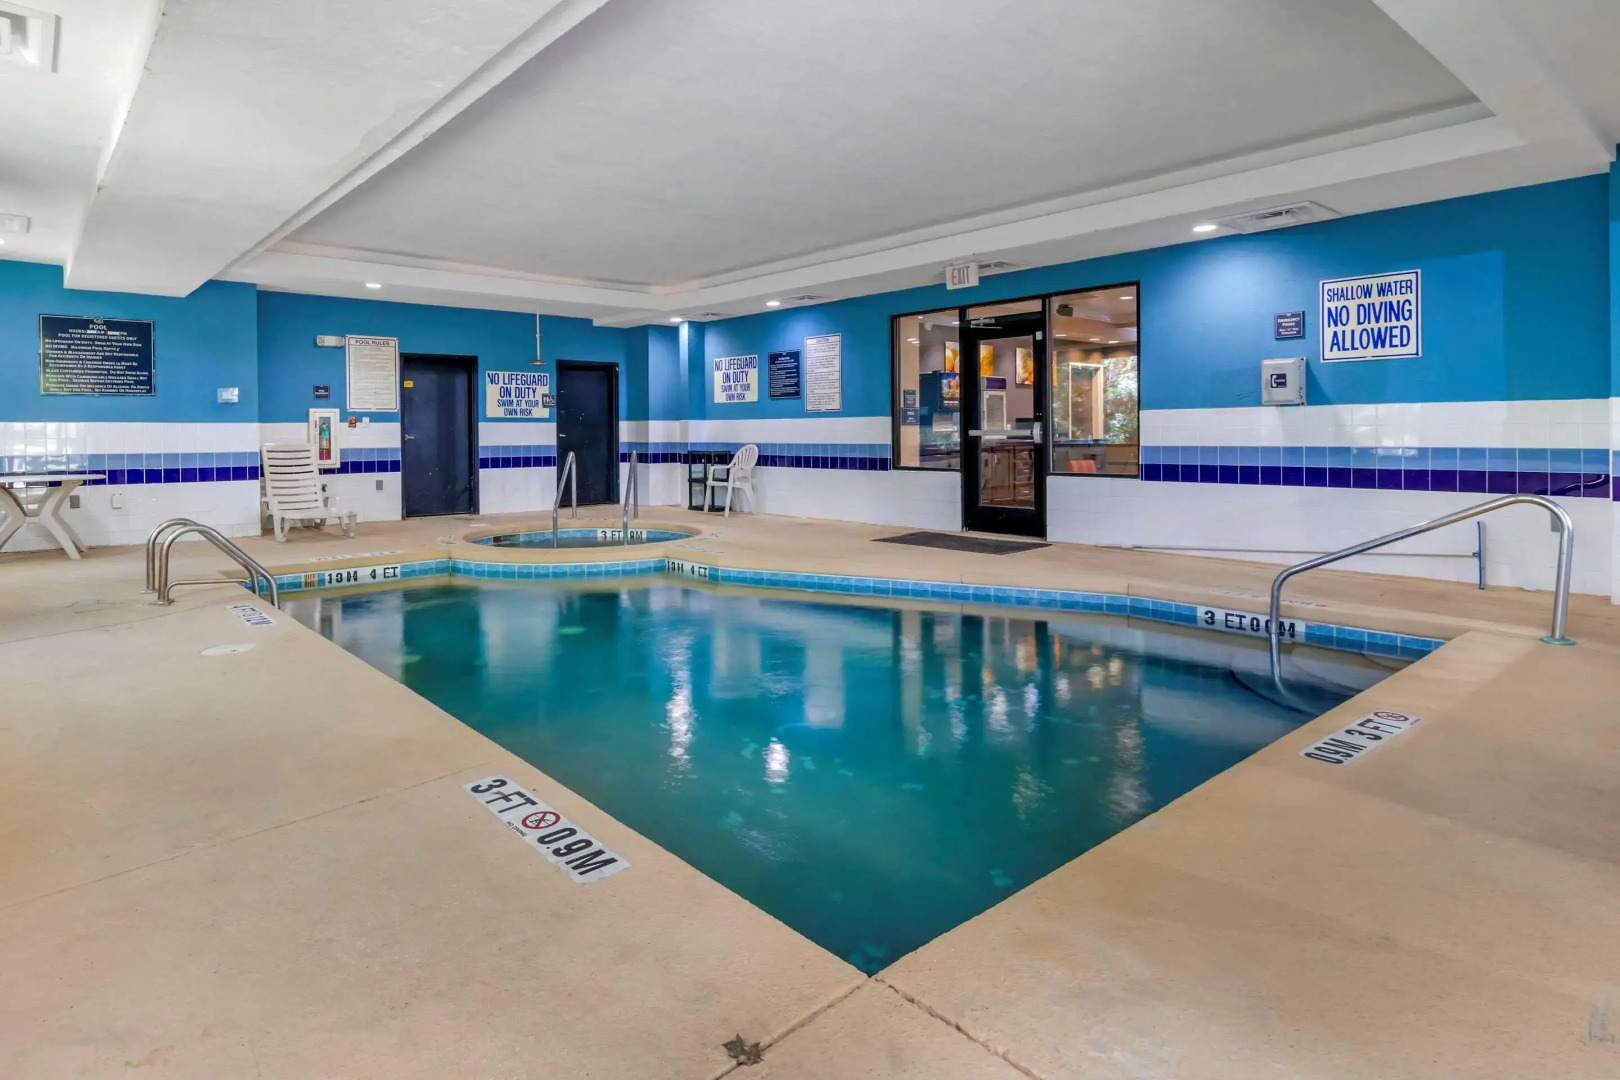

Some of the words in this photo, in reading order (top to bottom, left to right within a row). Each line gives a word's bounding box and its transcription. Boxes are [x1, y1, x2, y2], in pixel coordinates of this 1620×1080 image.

[952, 266, 970, 286] EXIT
[1326, 283, 1373, 302] SHALLOW
[1376, 279, 1413, 298] WATER
[1327, 305, 1350, 328] NO
[1356, 299, 1412, 326] DIVING
[1329, 324, 1411, 352] ALLOWED
[714, 360, 723, 372] NO
[724, 356, 757, 371] LIFEGUARD
[487, 372, 499, 385] NO
[503, 373, 548, 386] LIFEGUARD
[722, 372, 731, 384] ON
[732, 371, 749, 383] DUTY
[499, 386, 512, 398] ON
[515, 387, 537, 399] DUTY
[721, 384, 732, 393] SWIM
[740, 383, 751, 392] YOUR
[497, 399, 514, 407] SWIM
[725, 393, 735, 401] OWN
[736, 392, 746, 401] RISK
[504, 408, 518, 416] OWN
[520, 408, 533, 416] RISK
[1357, 718, 1402, 734] FT
[1344, 729, 1382, 740] 3
[470, 778, 508, 794] 3
[485, 791, 539, 814] FT
[512, 826, 527, 837] DIVING
[537, 827, 618, 876] 0.9M
